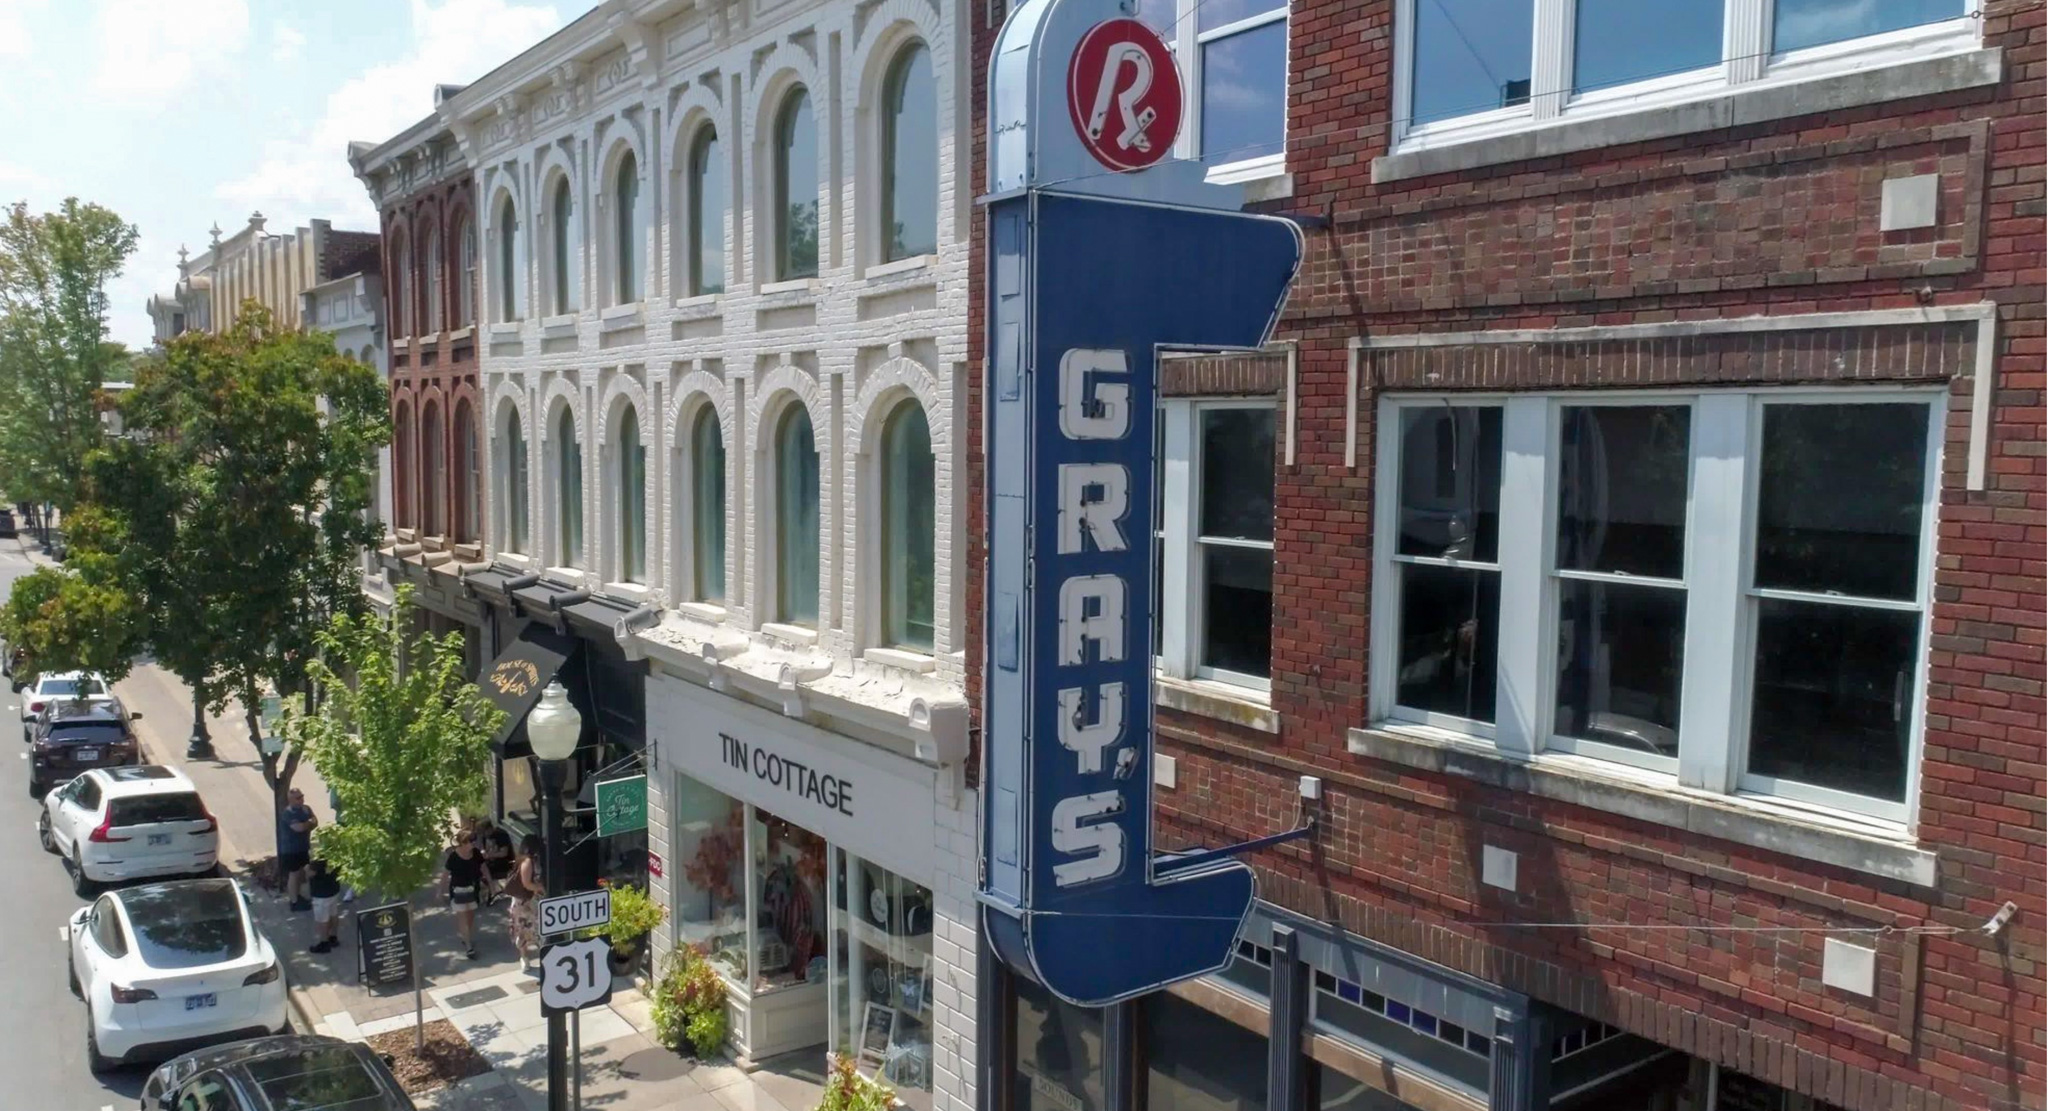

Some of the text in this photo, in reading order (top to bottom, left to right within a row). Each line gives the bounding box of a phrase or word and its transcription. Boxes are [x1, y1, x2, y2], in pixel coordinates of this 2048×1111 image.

[1052, 348, 1139, 887] GRAY'S
[718, 732, 854, 817] TIN COTTAGE
[606, 804, 639, 817] Ctage
[544, 897, 606, 927] SOUTH
[555, 951, 595, 994] 31
